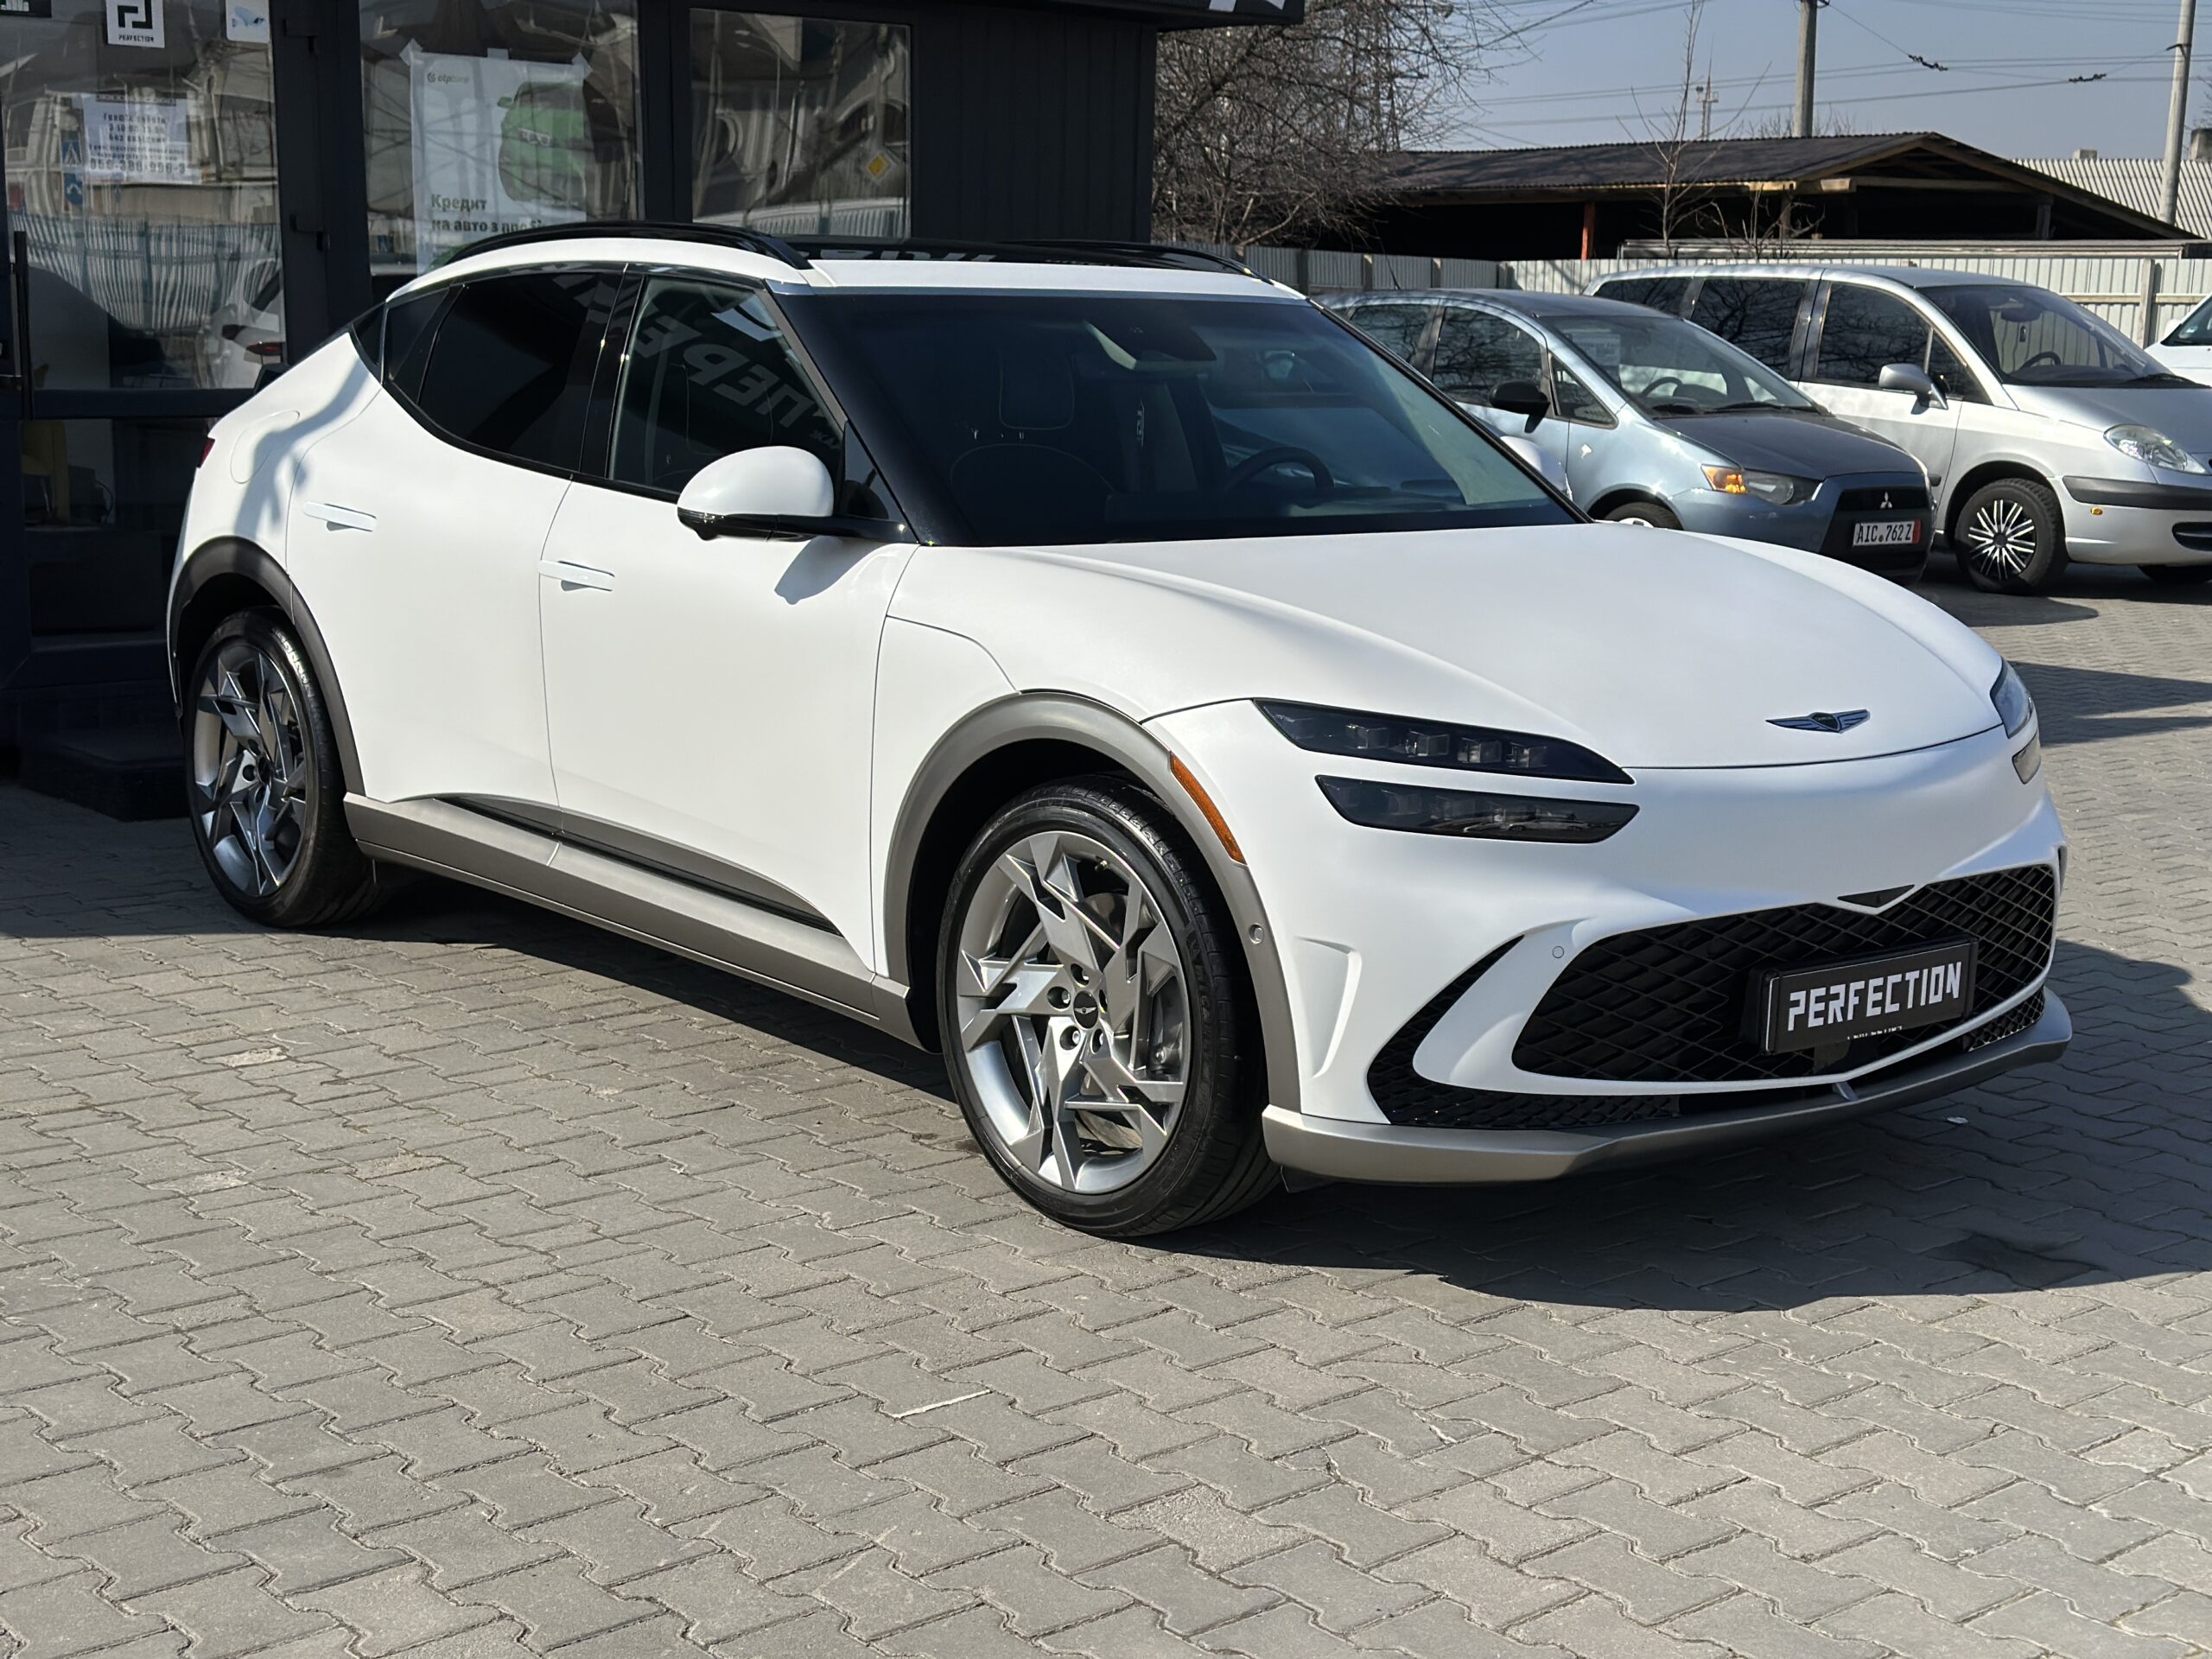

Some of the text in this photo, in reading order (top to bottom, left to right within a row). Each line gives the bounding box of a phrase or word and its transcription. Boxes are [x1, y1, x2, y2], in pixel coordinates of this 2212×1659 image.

[431, 194, 487, 213] Кредит
[431, 219, 450, 232] на
[454, 220, 488, 232] авто
[1788, 962, 1962, 1031] PERFECTION
